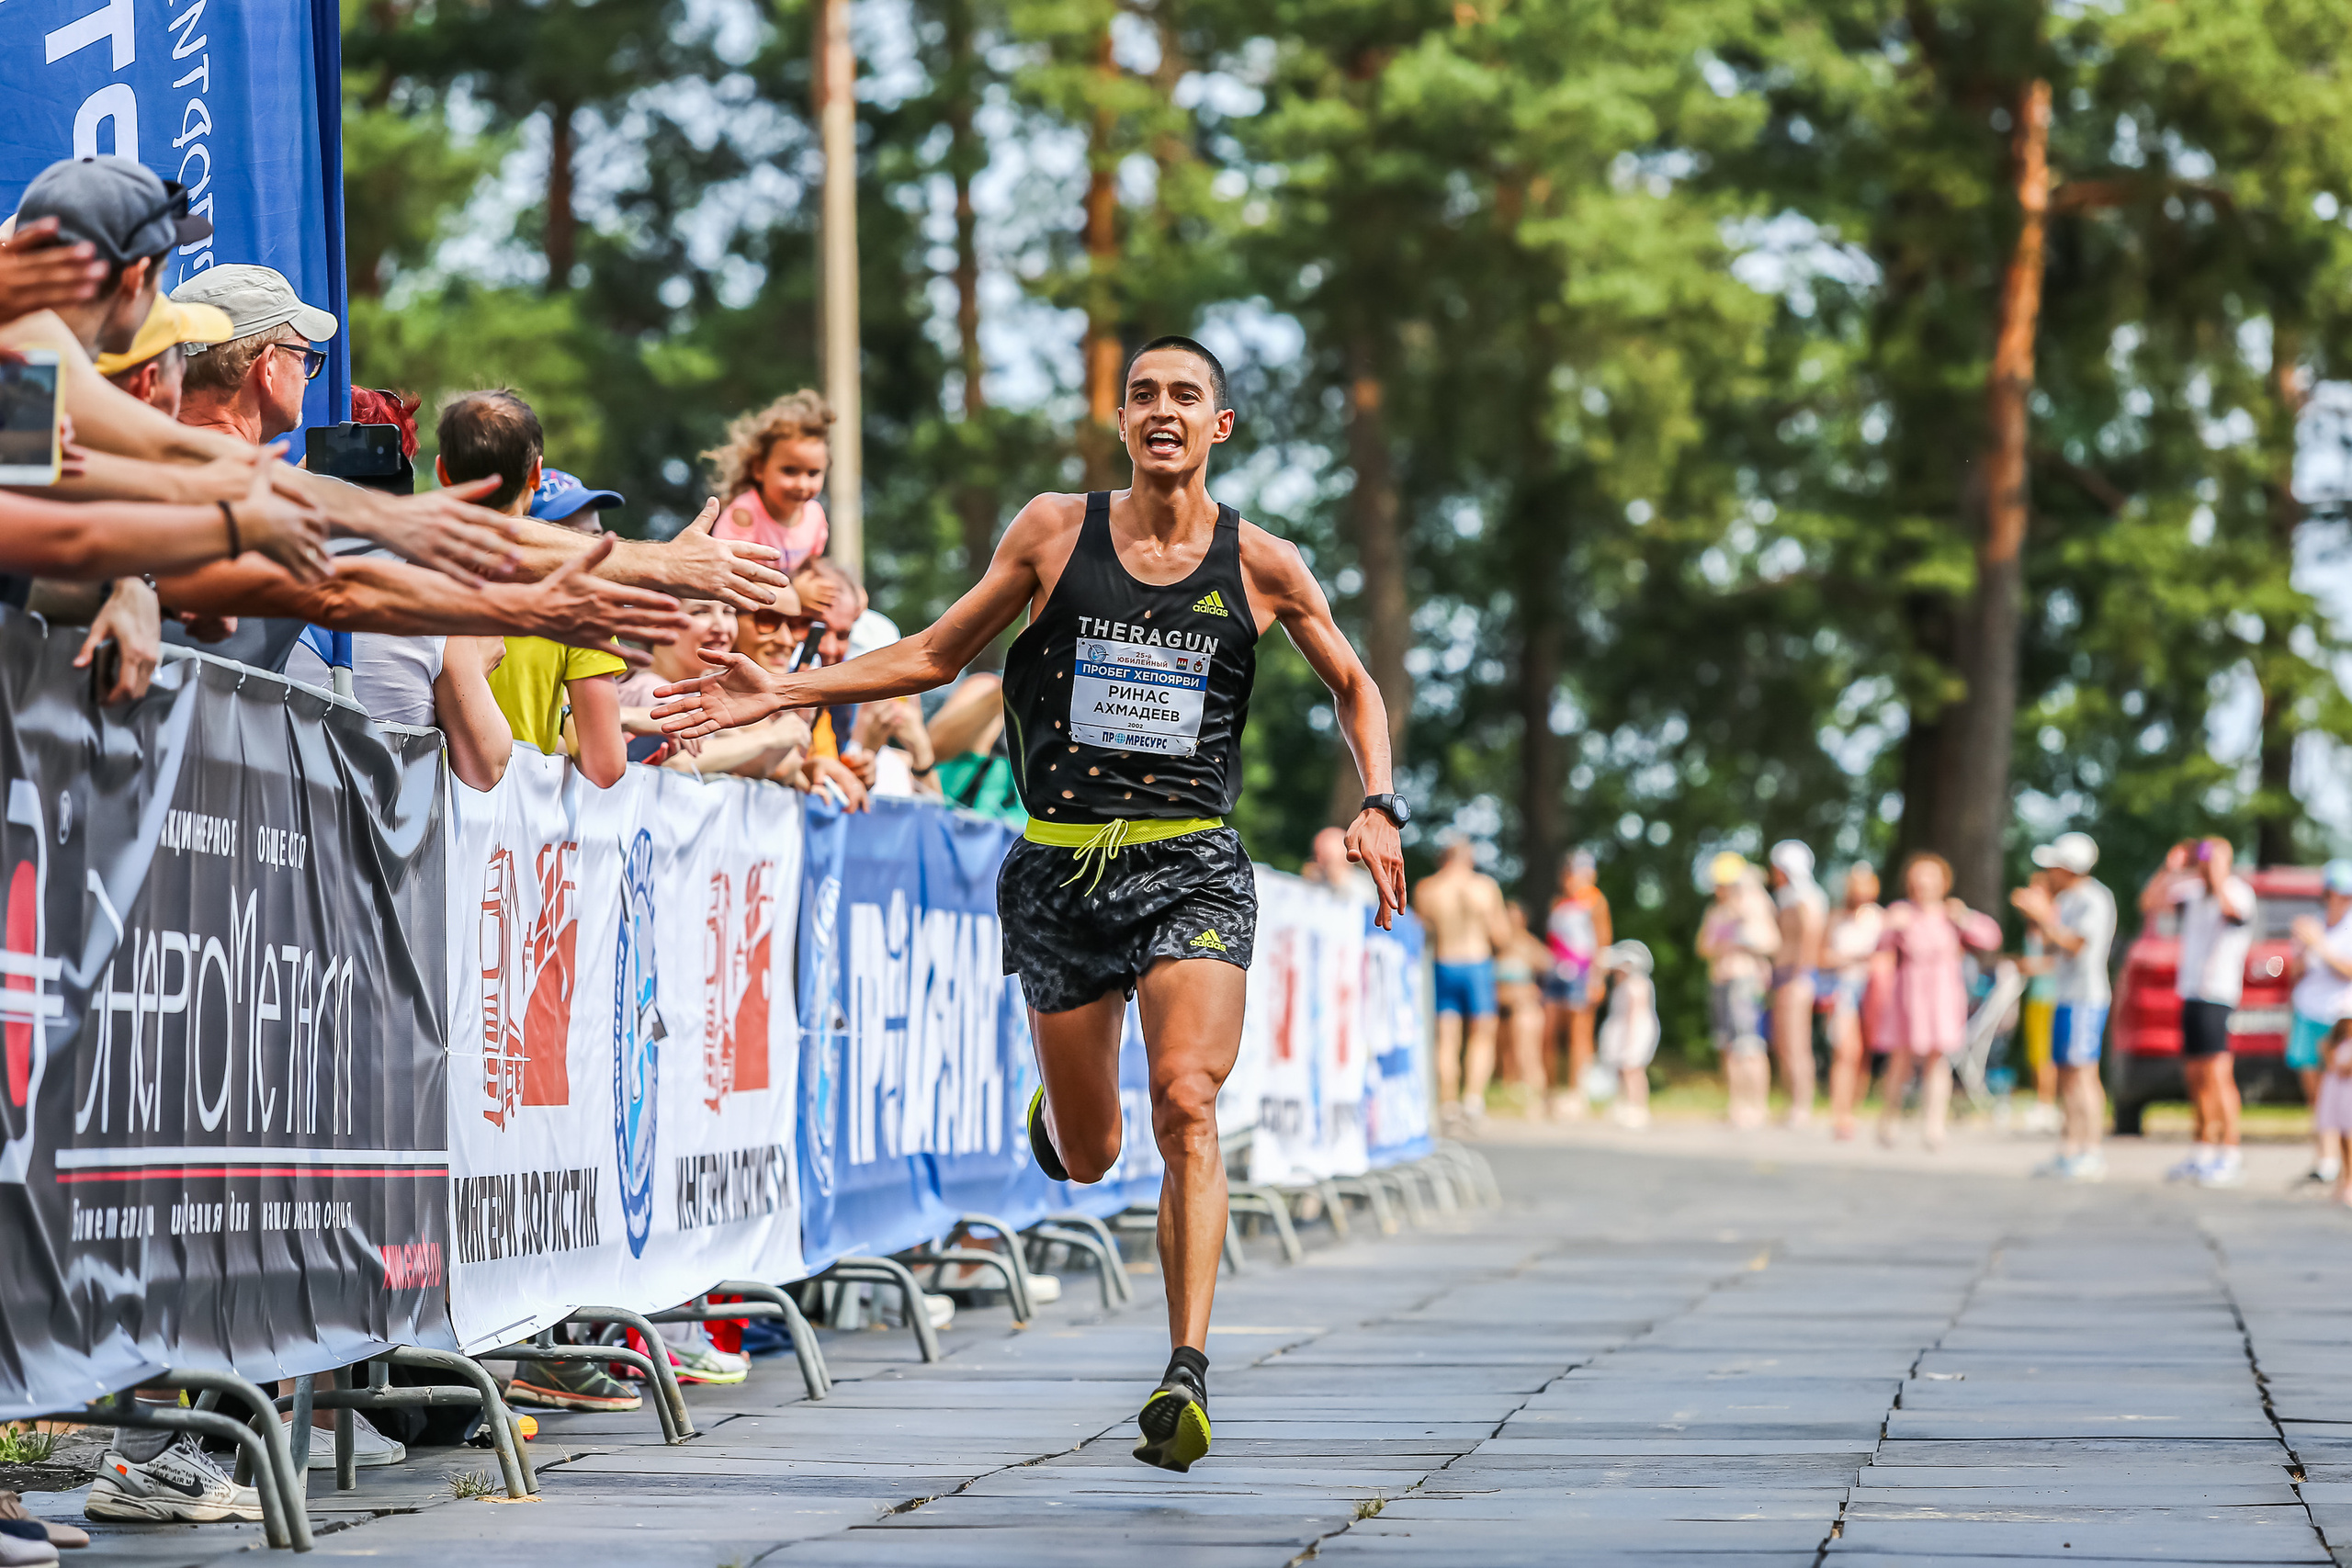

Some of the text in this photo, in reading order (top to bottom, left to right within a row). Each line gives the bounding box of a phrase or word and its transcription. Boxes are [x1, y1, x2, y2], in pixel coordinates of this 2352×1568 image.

[1192, 604, 1229, 617] adidas
[1079, 615, 1219, 656] THERAGUN
[1116, 656, 1168, 668] ЮБИЛЕЙНЫЙ
[1082, 663, 1200, 688] ПРОБЕГ ХЕПОЯРВИ
[1108, 684, 1170, 705] РИНАС
[1093, 701, 1180, 723] АХМАДЕЕВ
[1127, 721, 1144, 729] 2002
[1189, 939, 1227, 953] adidas
